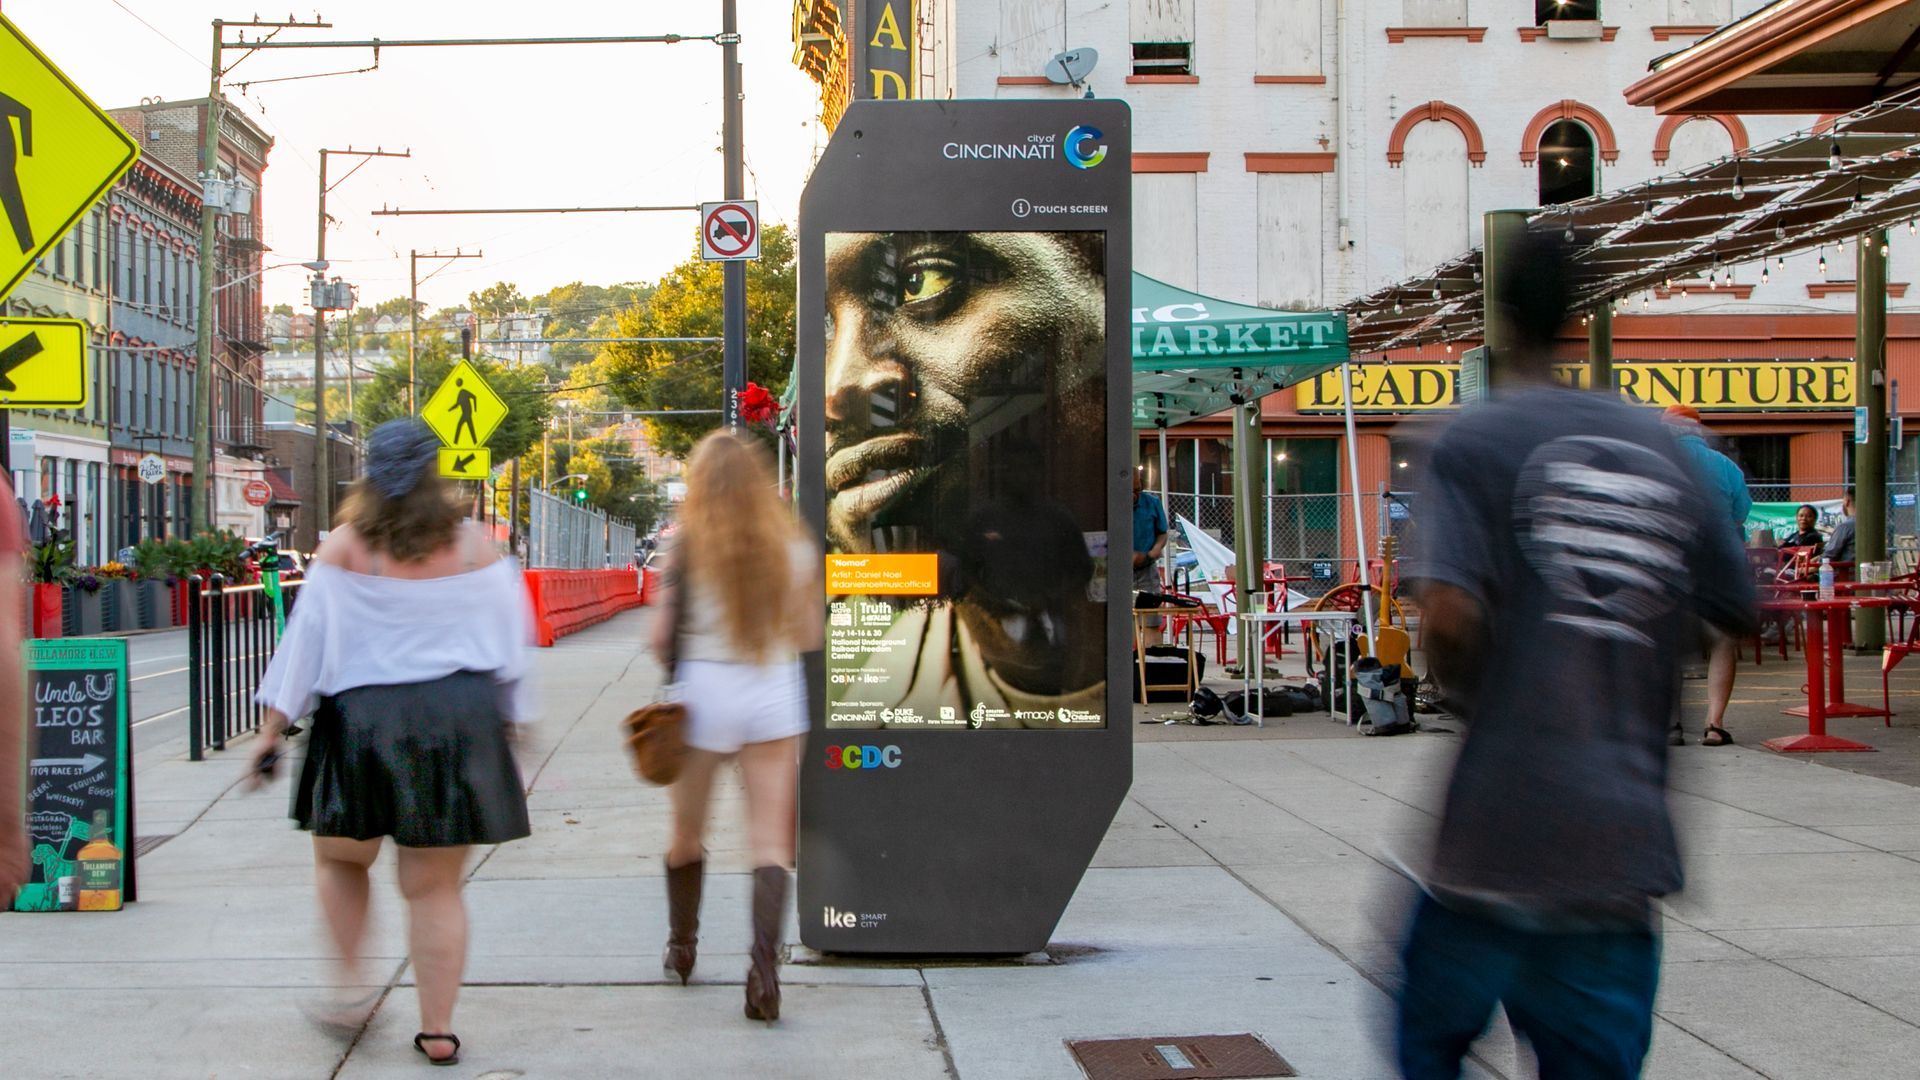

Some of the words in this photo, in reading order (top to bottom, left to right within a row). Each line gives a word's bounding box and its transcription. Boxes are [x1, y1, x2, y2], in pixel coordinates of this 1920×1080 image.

[1027, 134, 1045, 144] city
[1045, 134, 1056, 143] of
[943, 142, 1055, 159] CINCINNATI
[1033, 205, 1067, 214] TOUCH
[1070, 205, 1108, 214] SCREEN
[831, 559, 870, 567] "Nomad"
[860, 602, 892, 614] Truth
[831, 629, 845, 638] July
[847, 629, 865, 637] 14-16
[866, 629, 872, 637] &
[873, 629, 882, 637] 30
[861, 639, 907, 647] Underground
[28, 647, 86, 659] TULLAMORE
[864, 674, 879, 683] ike
[35, 681, 86, 703] Uncle
[34, 704, 104, 727] LEO'S
[831, 713, 876, 721] CINCINNATI
[894, 708, 914, 716] DUKE
[1023, 710, 1054, 721] macy's
[71, 729, 105, 745] BAR
[824, 745, 902, 769] 3CDC
[31, 767, 49, 776] 1709
[51, 767, 71, 775] RACE
[27, 780, 53, 802] BEER!
[45, 793, 85, 809] WHISKEY!
[82, 862, 116, 870] TULLAMORE
[823, 906, 857, 928] ike
[860, 913, 887, 921] SMART
